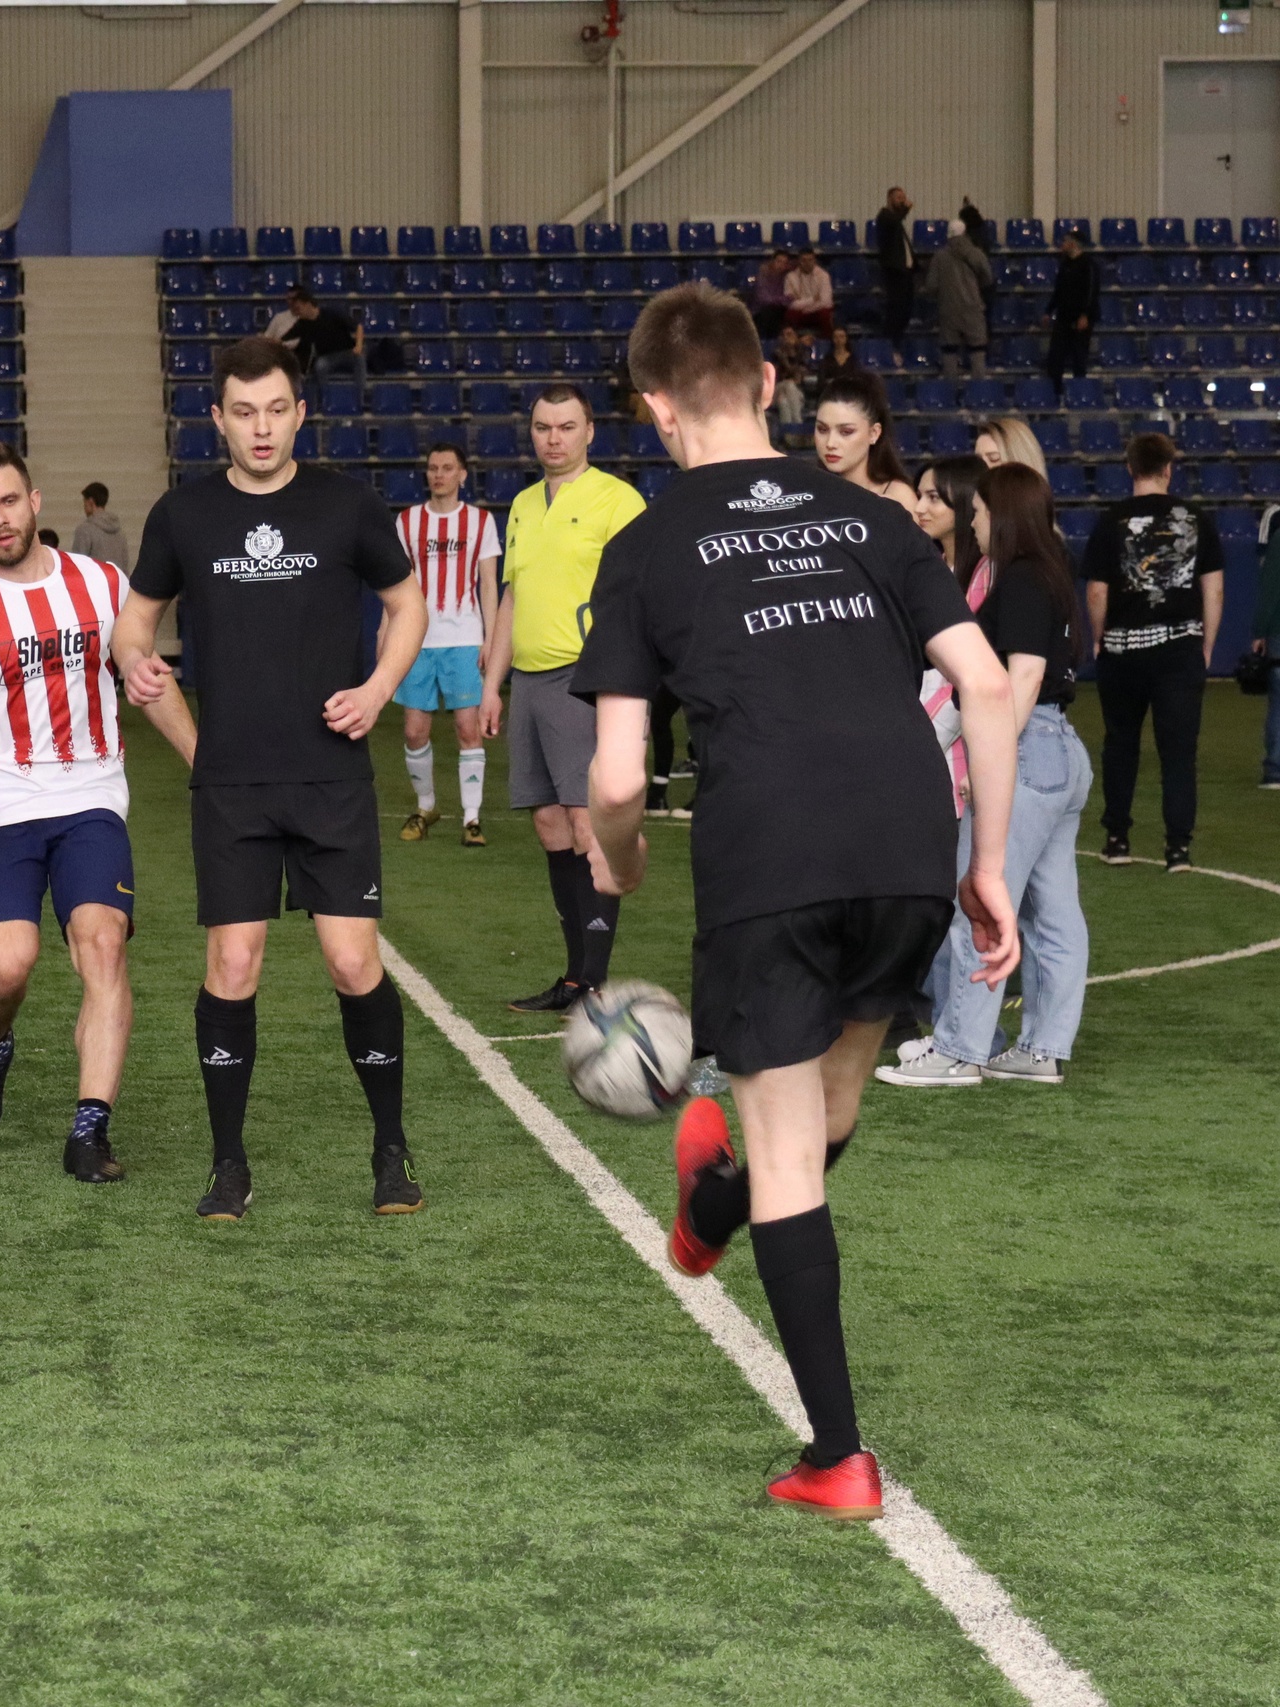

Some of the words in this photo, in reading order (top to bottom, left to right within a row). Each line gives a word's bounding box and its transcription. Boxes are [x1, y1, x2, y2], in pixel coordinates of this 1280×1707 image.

[727, 494, 814, 510] BEERLOGOVO
[426, 538, 468, 553] Shelter
[698, 522, 868, 565] BRLOGOVO
[212, 556, 318, 574] BEERLOGOVO
[767, 555, 824, 574] team
[743, 592, 875, 635] ЕВГЕНИЙ
[17, 627, 98, 669] Shelter
[14, 665, 42, 680] VAPE
[202, 1057, 243, 1066] DEMIX
[355, 1055, 398, 1065] DEMIX
